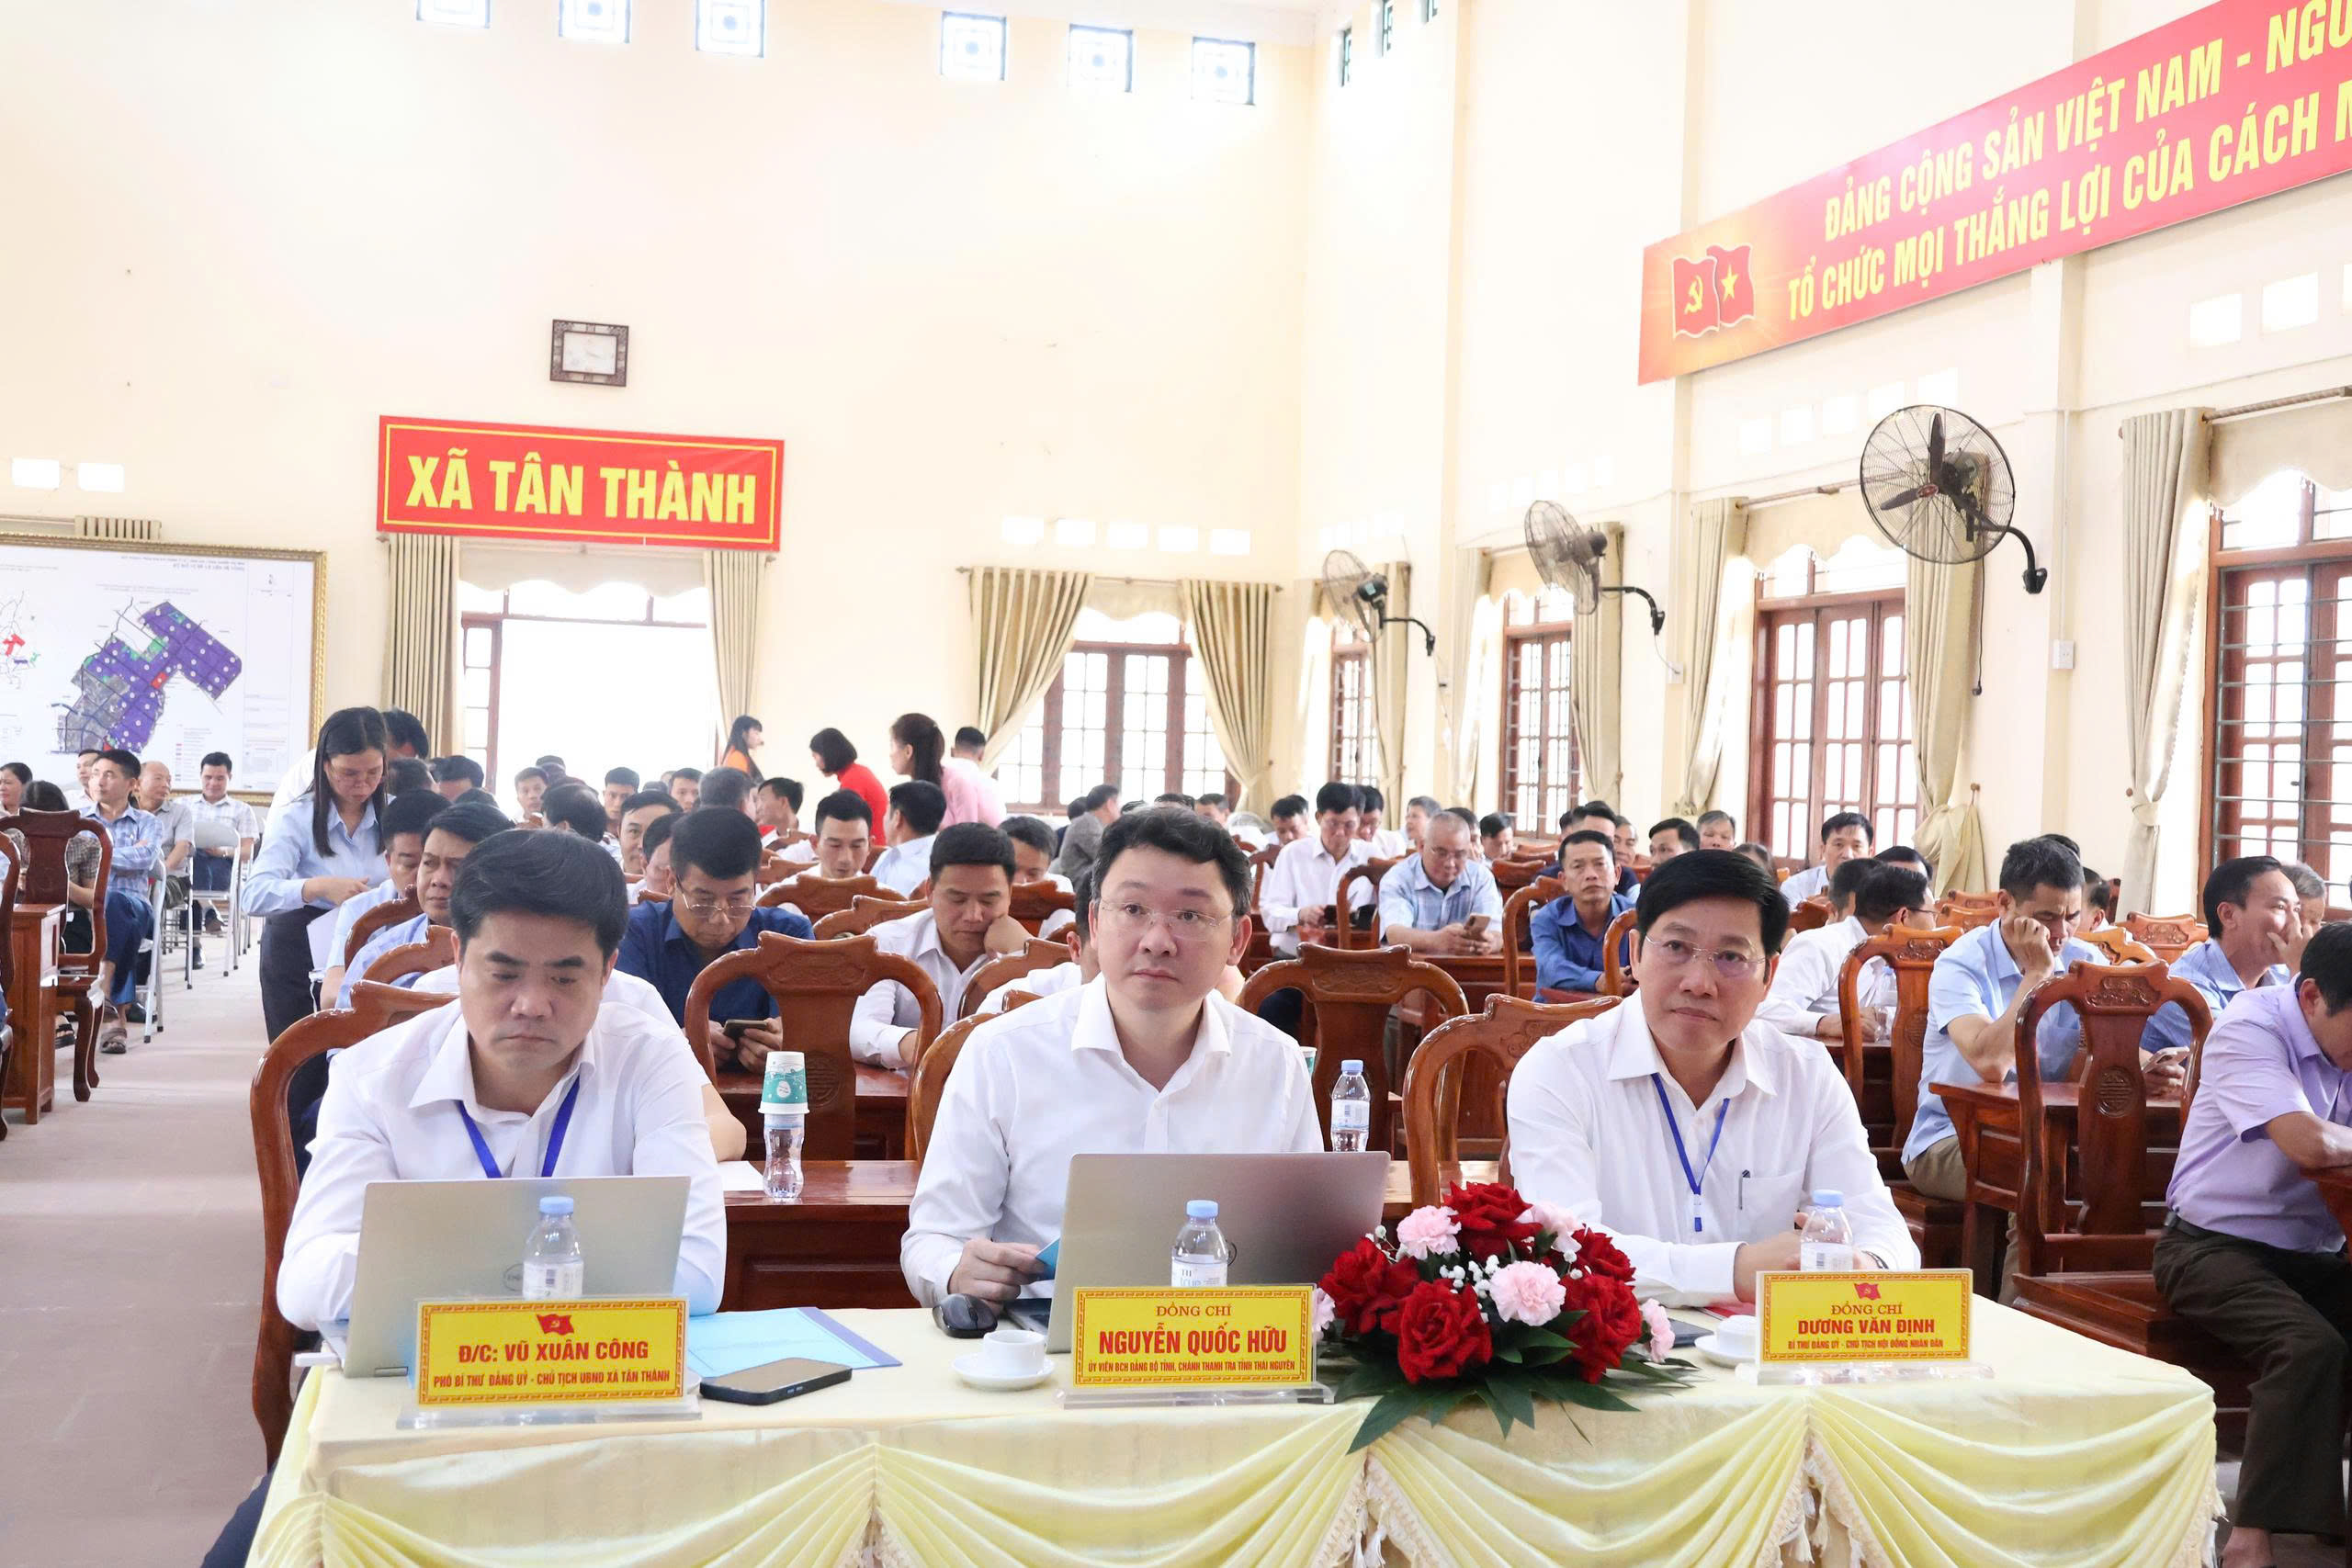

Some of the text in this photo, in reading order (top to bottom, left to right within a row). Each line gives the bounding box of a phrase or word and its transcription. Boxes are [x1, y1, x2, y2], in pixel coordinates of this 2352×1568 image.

[1825, 175, 1891, 241] ĐẢNG
[1899, 148, 1973, 214] CỘNG
[1983, 107, 2045, 179] SẢN
[2055, 76, 2126, 151] VIỆT
[2135, 39, 2223, 123] NAM
[1788, 255, 1816, 321] TỔ
[1822, 243, 1886, 310] CHỨC
[1894, 227, 1944, 288] MỌI
[1954, 187, 2049, 265] THẮNG
[2059, 164, 2110, 236] LỢI
[2122, 129, 2194, 209] CỦA
[2208, 91, 2320, 182] CÁCH
[405, 447, 756, 525] XÃ TÂN THÀNH
[1156, 1302, 1232, 1316] ĐỒNG CHÍ
[1831, 1301, 1903, 1315] ĐỒNG CHÍ
[1798, 1316, 1935, 1337] DƯƠNG VĂN ĐỊNH
[458, 1338, 649, 1363] Đ/C: VŨ XUÂN CÔNG
[1099, 1322, 1287, 1356] NGUYỄN QUỐC HỮU
[1098, 1360, 1114, 1371] VIÊN
[1114, 1362, 1129, 1371] BCH
[1149, 1359, 1159, 1373] BỘ
[1202, 1361, 1223, 1371] THANH
[1225, 1361, 1236, 1371] TRA
[1270, 1359, 1295, 1371] NGUYÊN
[434, 1373, 452, 1387] PHÓ
[467, 1373, 485, 1386] THƯ
[537, 1369, 555, 1385] CHỦ
[557, 1371, 577, 1387] TỊCH
[580, 1371, 605, 1383] UBND
[622, 1369, 639, 1382] TÂN
